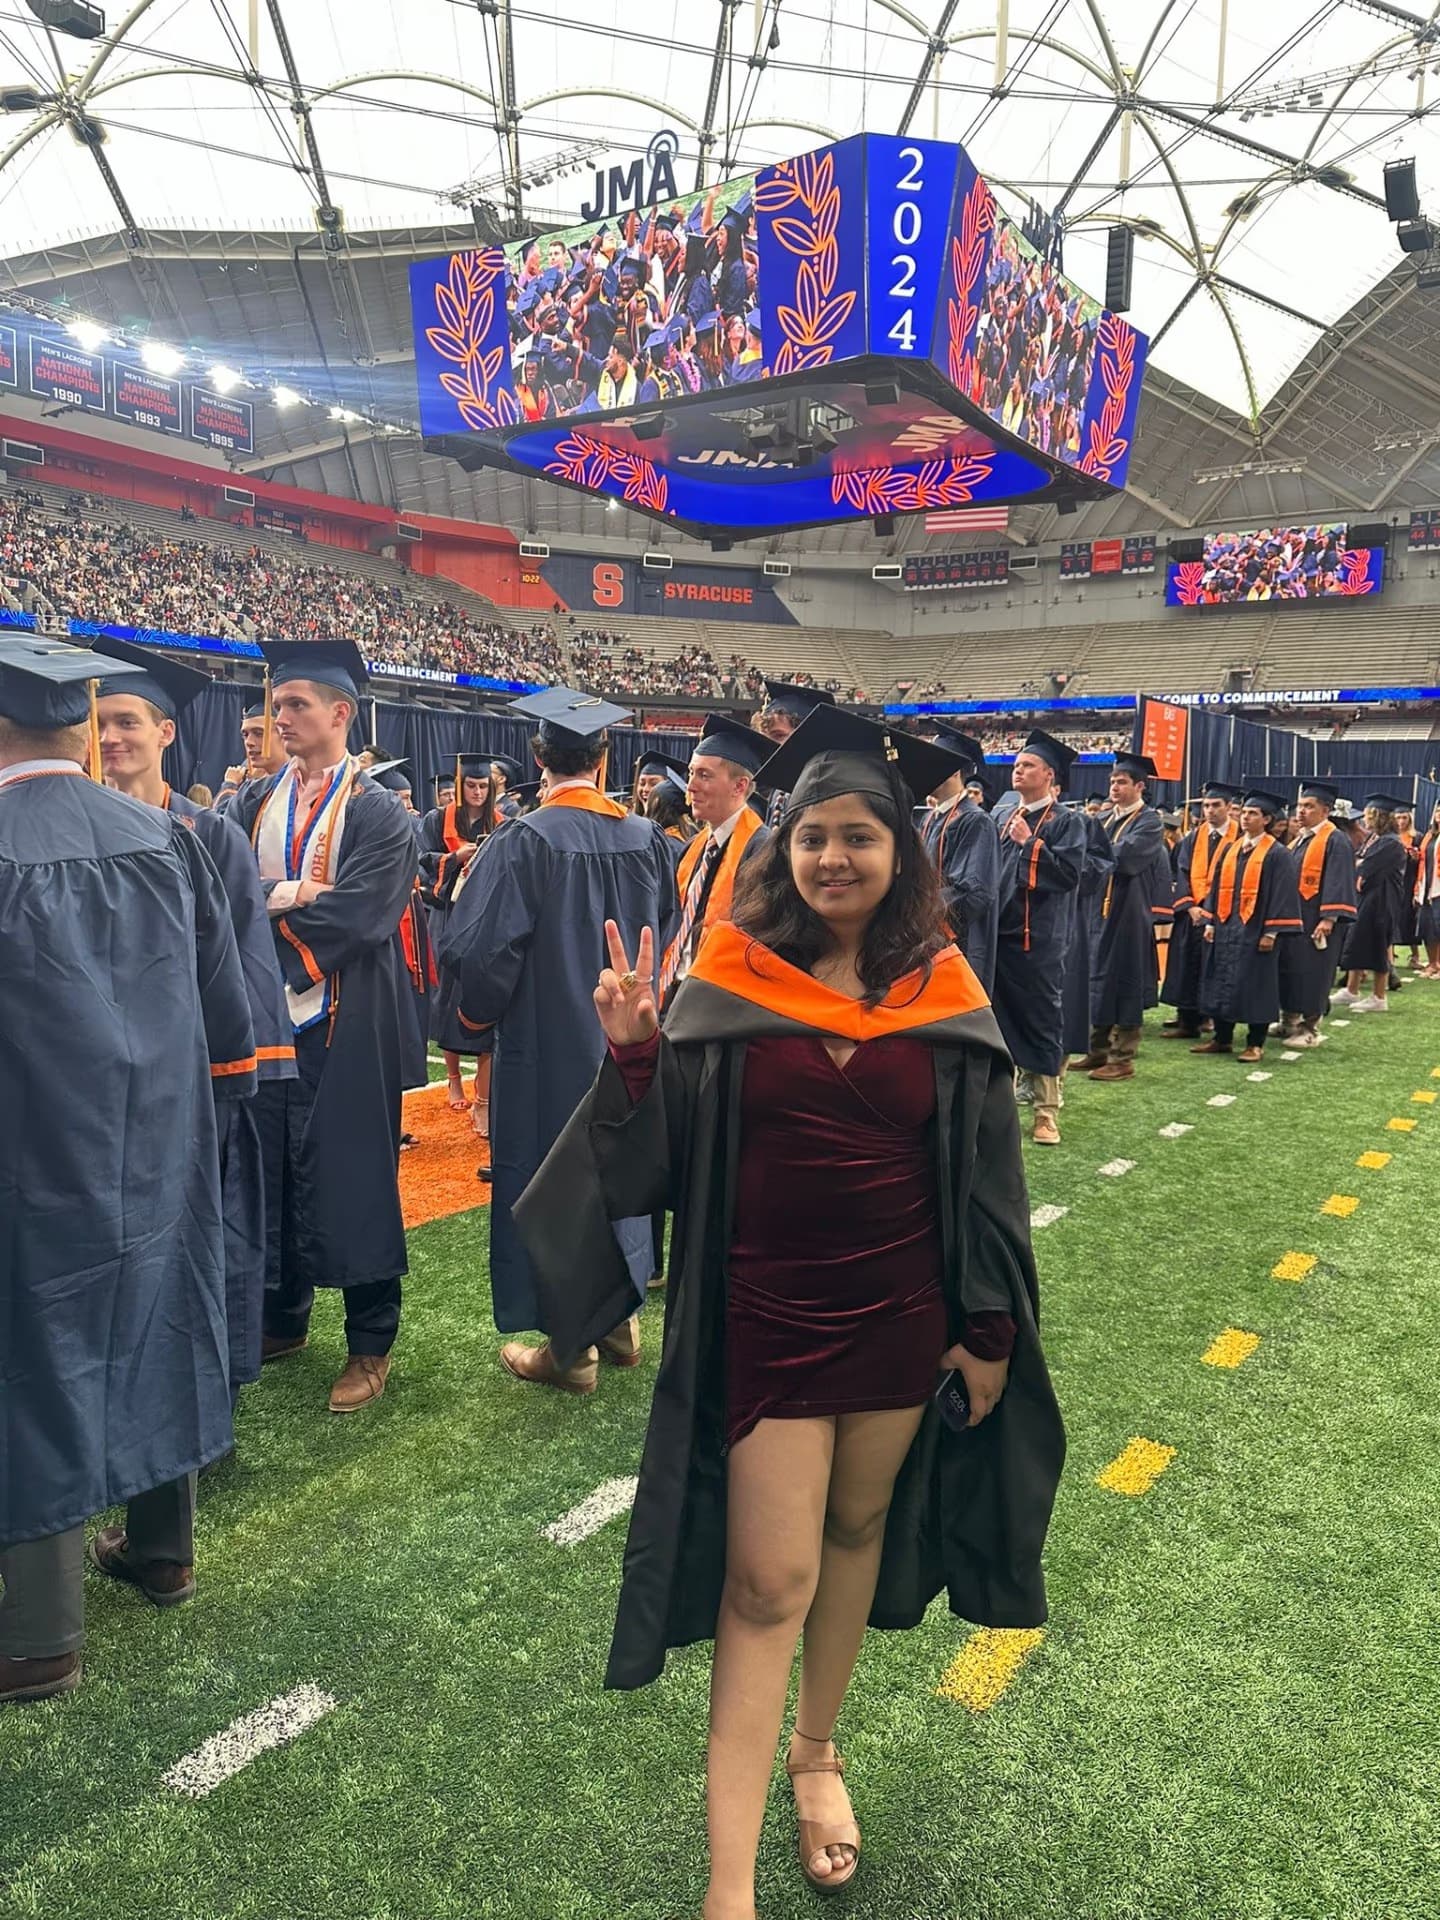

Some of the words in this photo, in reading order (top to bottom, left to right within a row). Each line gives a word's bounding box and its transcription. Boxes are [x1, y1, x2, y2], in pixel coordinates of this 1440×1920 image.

[581, 150, 679, 221] JMA
[887, 147, 924, 350] 2024
[40, 356, 95, 381] NATIONAL
[61, 351, 93, 367] LACROSSE
[35, 366, 100, 393] CHAMPIONS
[53, 387, 82, 405] 1990
[118, 391, 177, 416] CHAMPIONS
[123, 381, 172, 404] NATIONAL
[134, 410, 161, 427] 1993
[195, 414, 249, 438] CHAMPIONS
[200, 405, 245, 426] NATIONAL
[209, 432, 234, 448] 1995
[592, 562, 624, 608] S
[664, 581, 753, 604] SYRACUSE
[371, 662, 458, 683] COMMENCEMENT
[1202, 693, 1220, 704] TO
[1222, 690, 1341, 704] COMMENCEMENT
